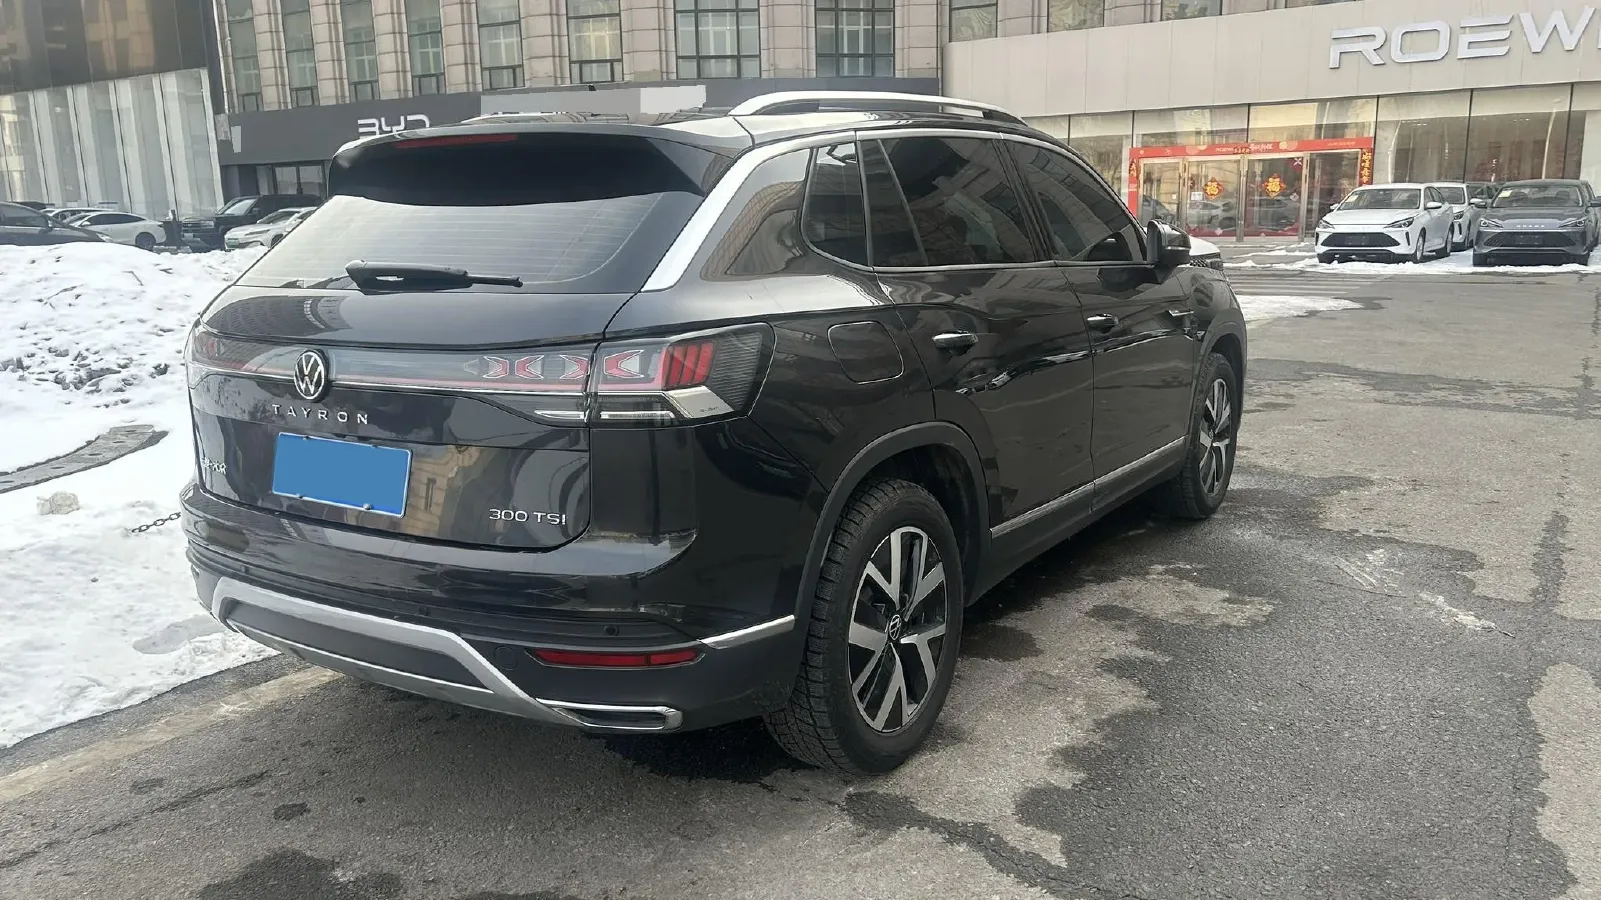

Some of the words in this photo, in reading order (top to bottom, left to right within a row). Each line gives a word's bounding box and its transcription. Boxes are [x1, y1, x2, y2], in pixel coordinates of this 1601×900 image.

[1328, 7, 1601, 69] ROEW
[357, 114, 430, 138] BYD
[272, 404, 368, 425] TAYRON
[489, 508, 528, 522] 300
[533, 511, 566, 526] TSI
